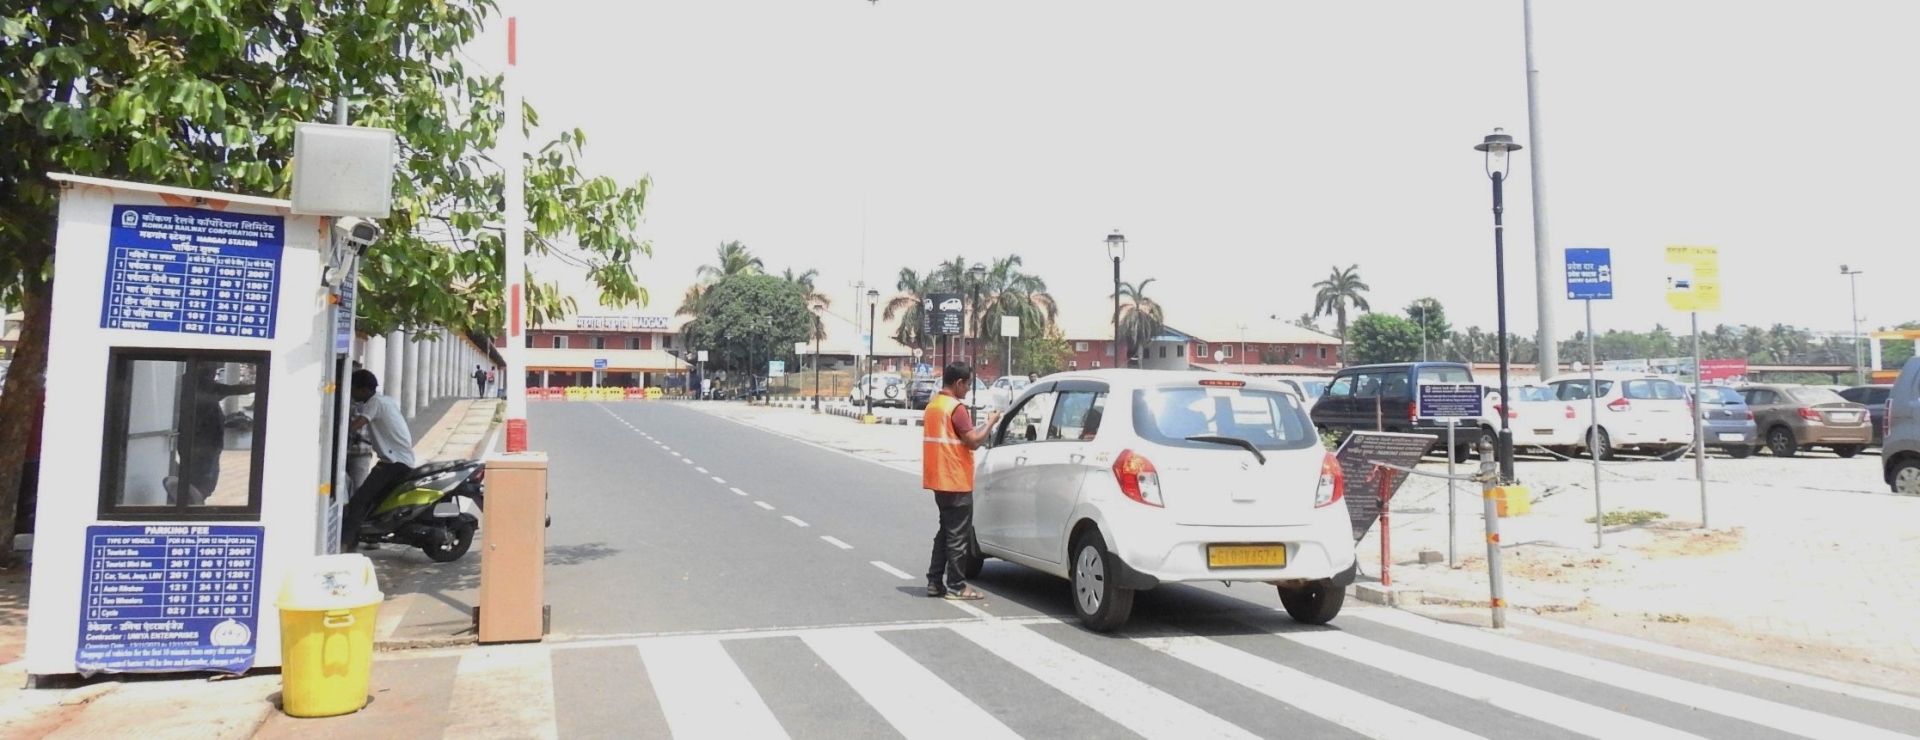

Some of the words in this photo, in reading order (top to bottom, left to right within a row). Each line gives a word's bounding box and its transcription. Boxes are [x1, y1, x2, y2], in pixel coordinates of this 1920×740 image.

[174, 214, 194, 225] रेलवे
[241, 220, 275, 232] लिमिटेड
[142, 222, 173, 230] KONKAN
[175, 224, 206, 233] RAILWAY
[208, 227, 258, 237] CORPORATION
[260, 231, 274, 239] LTD.
[228, 238, 258, 247] STATION
[632, 316, 669, 329] MADGAON
[144, 526, 189, 535] PARKING
[191, 526, 210, 535] FEE
[116, 597, 143, 605] Wheelers
[102, 609, 119, 618] Cycle
[86, 633, 122, 641] Contractor
[150, 631, 199, 640] ENTERPRISES
